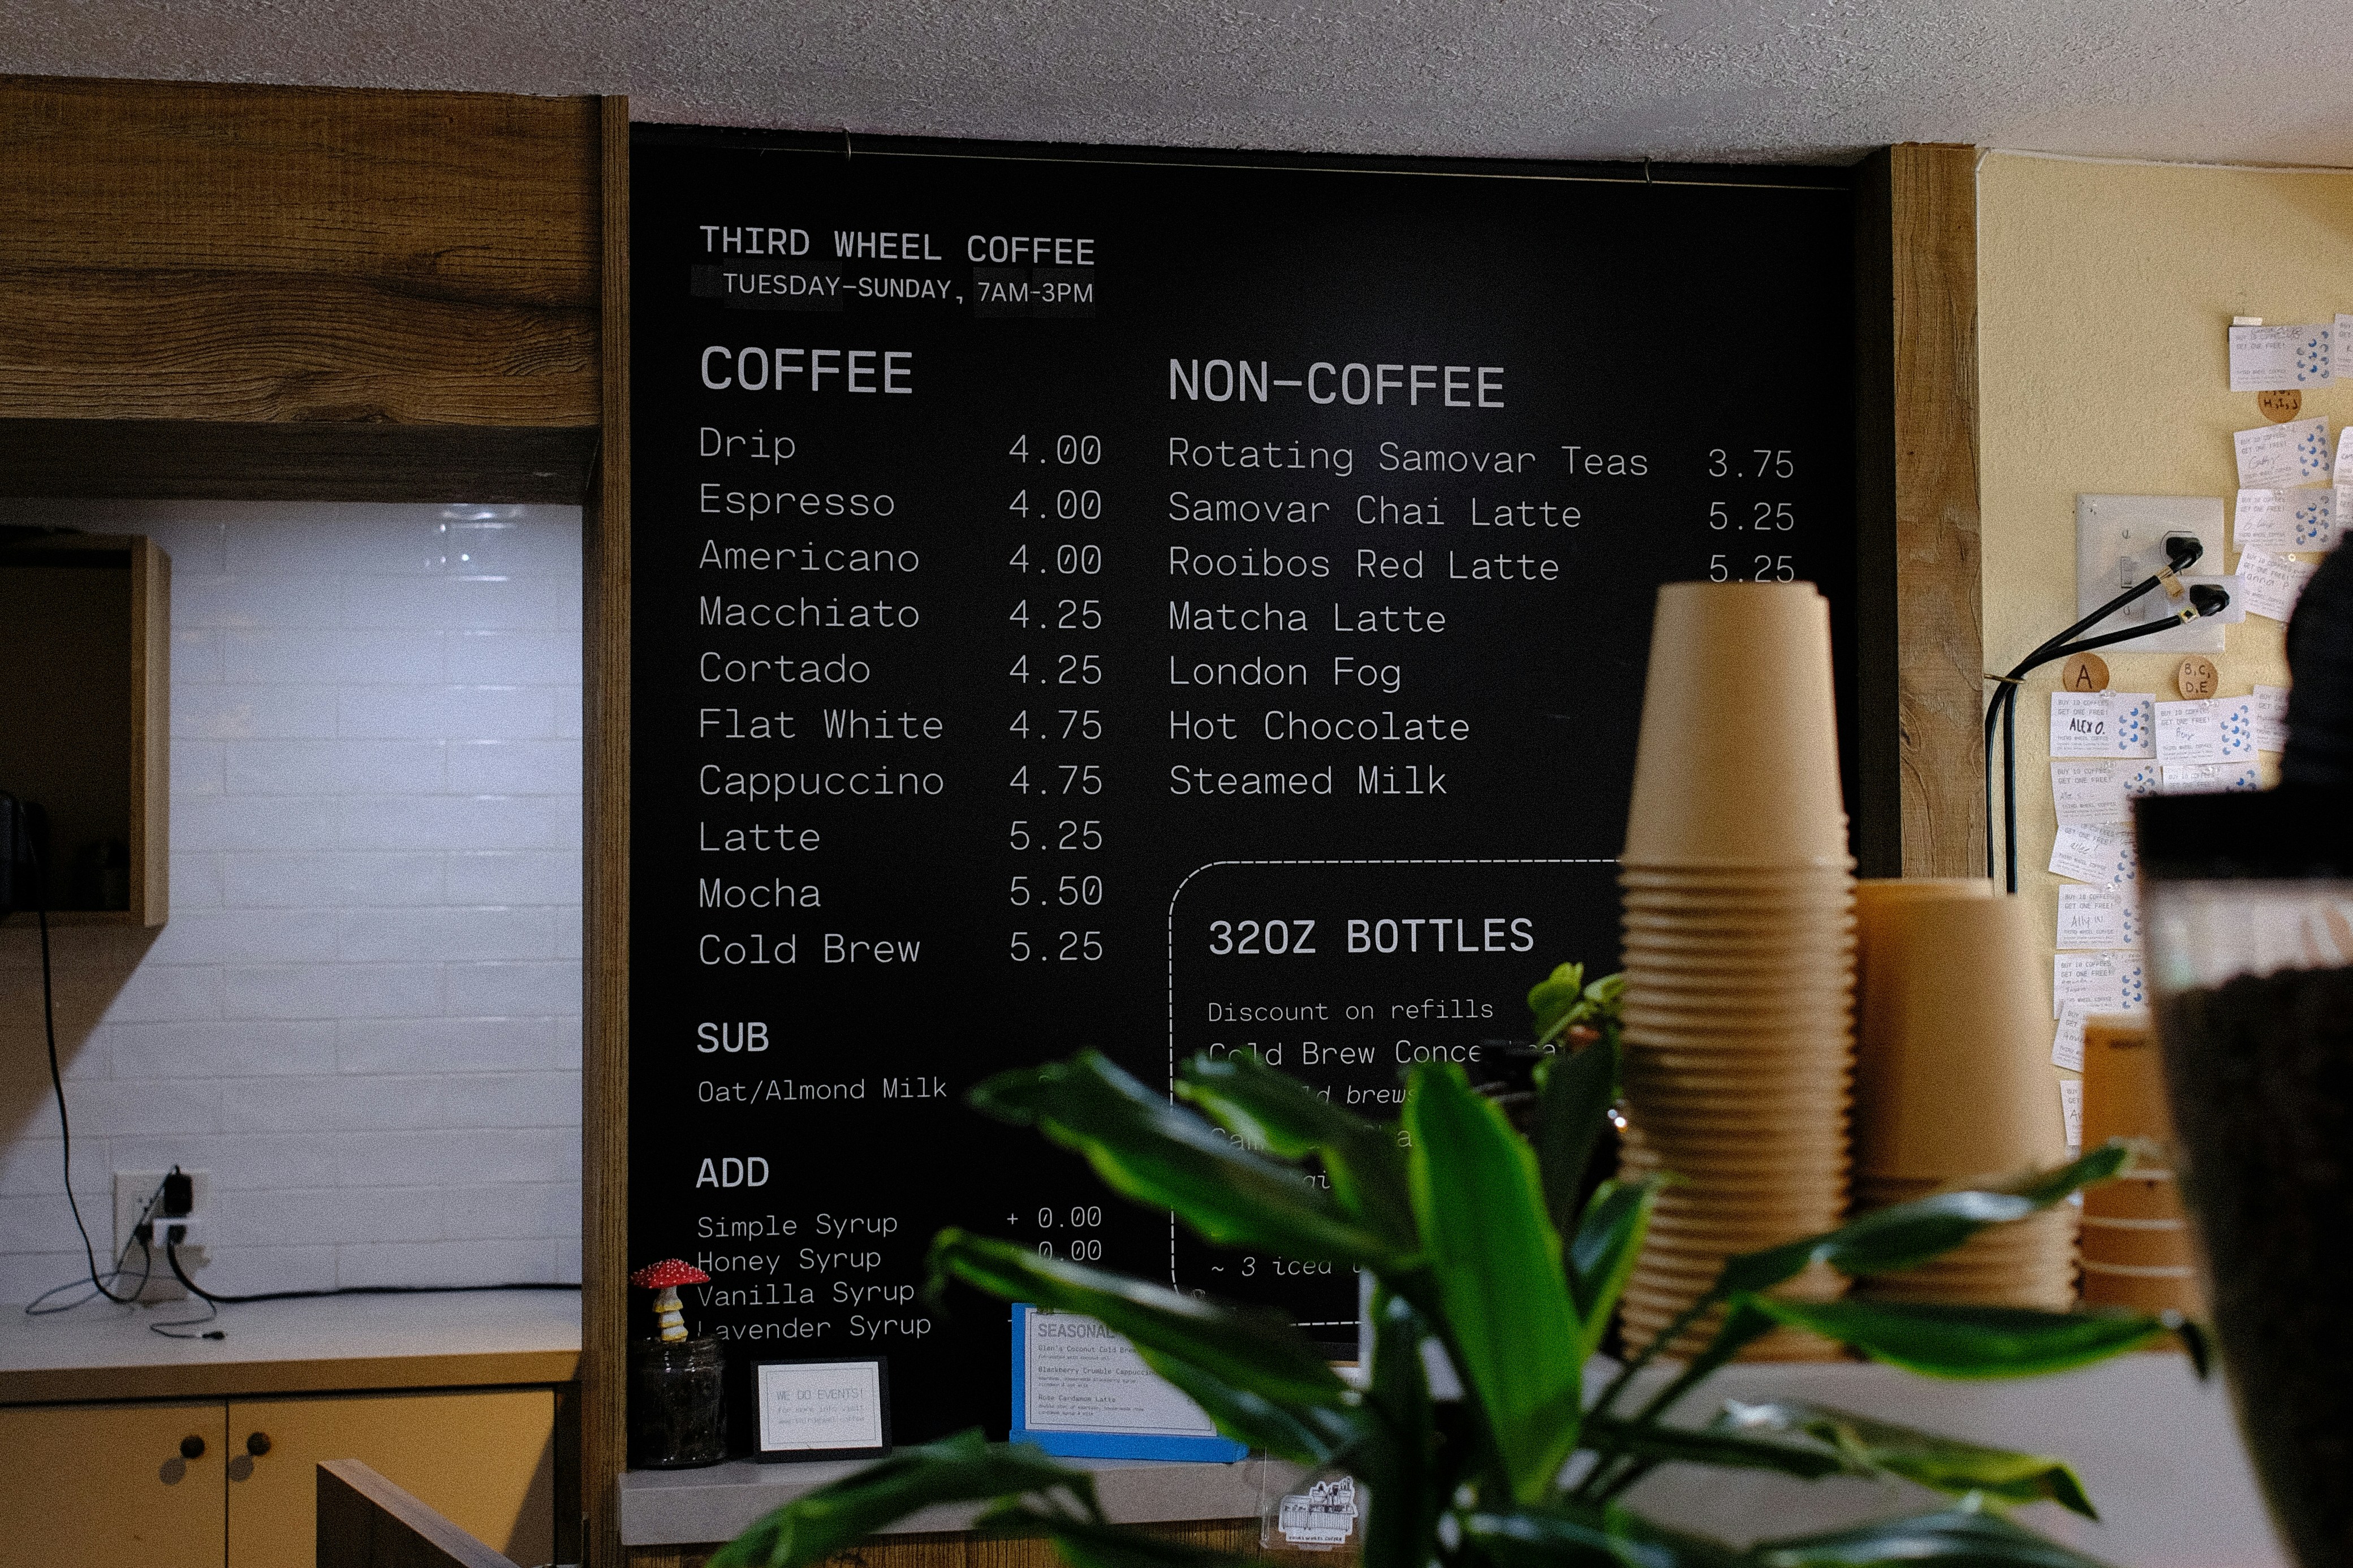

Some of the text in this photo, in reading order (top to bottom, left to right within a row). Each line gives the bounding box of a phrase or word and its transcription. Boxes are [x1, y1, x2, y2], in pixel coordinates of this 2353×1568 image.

[700, 225, 1094, 265] THIRD WHEEL COFFEE
[977, 282, 1093, 303] 7AM-3PM
[701, 345, 912, 394] COFFEE
[1170, 358, 1505, 408] NON-COFFEE
[701, 427, 1101, 464] Drip 4.00
[1170, 438, 1793, 478] Rotating Samovar Teas 3.75
[701, 483, 1101, 520] Espresso 4.00
[1170, 491, 1794, 530] Samovar Chai Latte 5.25
[700, 540, 1101, 574] Americano 4.00
[1170, 546, 1794, 583] Rooibos Red Latte 5.25
[701, 597, 1101, 629] Macchiato 4.25
[1170, 601, 1445, 632] Matcha Latte
[701, 652, 1101, 684] Cortado 4.25
[1171, 656, 1400, 693] London Fog
[2075, 663, 2093, 690] A
[701, 709, 1101, 739] Flat White 4.75
[1171, 711, 1469, 740] Hot Chocolate
[700, 764, 1102, 801] Cappuccino 4.75
[1171, 765, 1446, 794] Steamed Milk
[701, 820, 1102, 851] Latte 5.25
[700, 876, 1102, 908] Mocha 5.50
[700, 931, 1102, 965] Cold Brew 5.25
[1348, 918, 1533, 953] BOTTLES
[1209, 999, 1493, 1022] Discount on refills
[697, 1022, 769, 1053] SUB
[1303, 1041, 1374, 1065] Brew
[699, 1077, 947, 1104] Oat/Almond Milk
[696, 1156, 769, 1188] ADD
[698, 1215, 797, 1241] Simple
[816, 1213, 898, 1238] Syrup
[1038, 1206, 1101, 1228] 0.00
[697, 1251, 779, 1274] Honey
[799, 1248, 881, 1271] Syrup
[1242, 1256, 1256, 1276] 3
[697, 1281, 915, 1306] Vanilla Syrup
[849, 1315, 931, 1339] Syrup
[1038, 1366, 1079, 1375] Blackberry
[777, 1388, 863, 1401] WE DO EVENTS!
